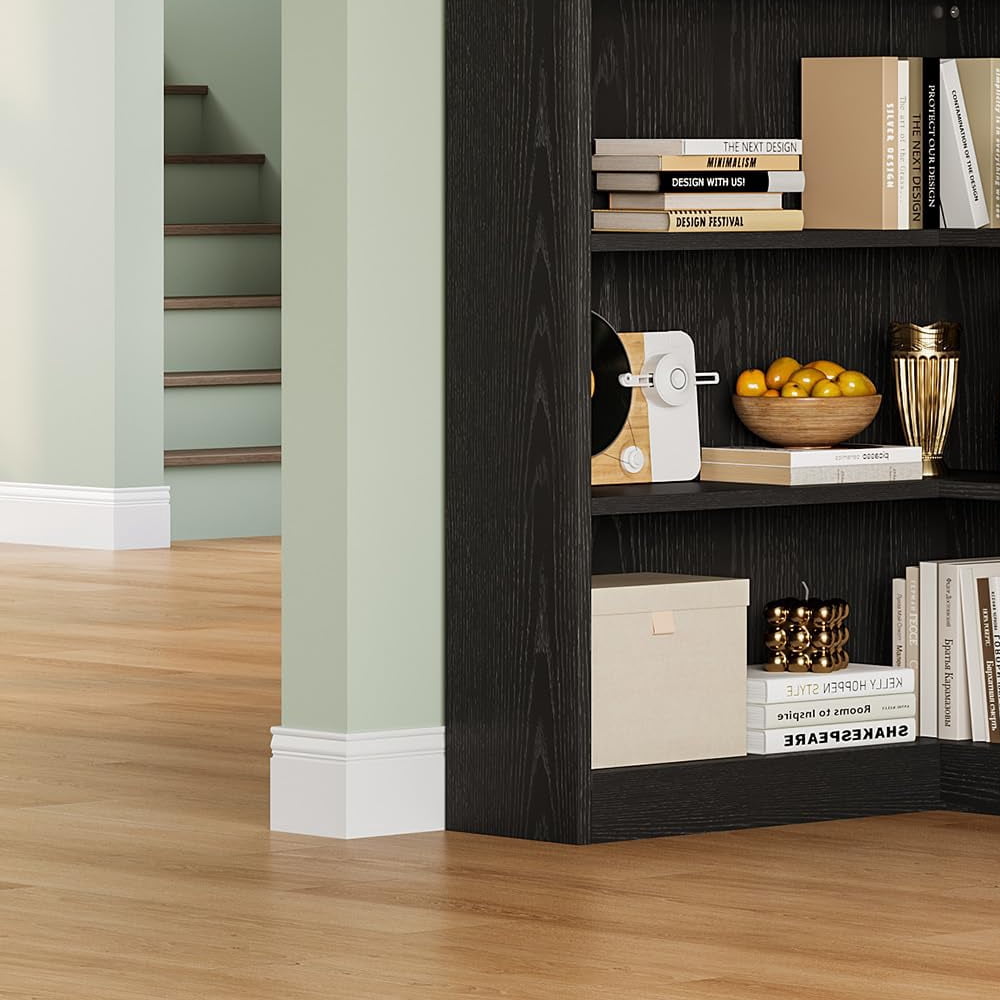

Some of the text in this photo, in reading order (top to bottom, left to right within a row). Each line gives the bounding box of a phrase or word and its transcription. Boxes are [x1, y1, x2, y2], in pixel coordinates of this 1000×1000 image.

[723, 142, 797, 152] THE NEXT DESIGN
[952, 90, 968, 149] CONTAMINATION
[964, 150, 970, 158] OF
[970, 175, 979, 201] DESIGN
[707, 158, 757, 168] MINIMALISM
[672, 178, 745, 187] DESIGN WITH US!
[676, 216, 744, 228] DESIGN FESTIVAL
[909, 613, 917, 646] ГЕССЕ
[942, 639, 952, 727] Братья Карамазовы
